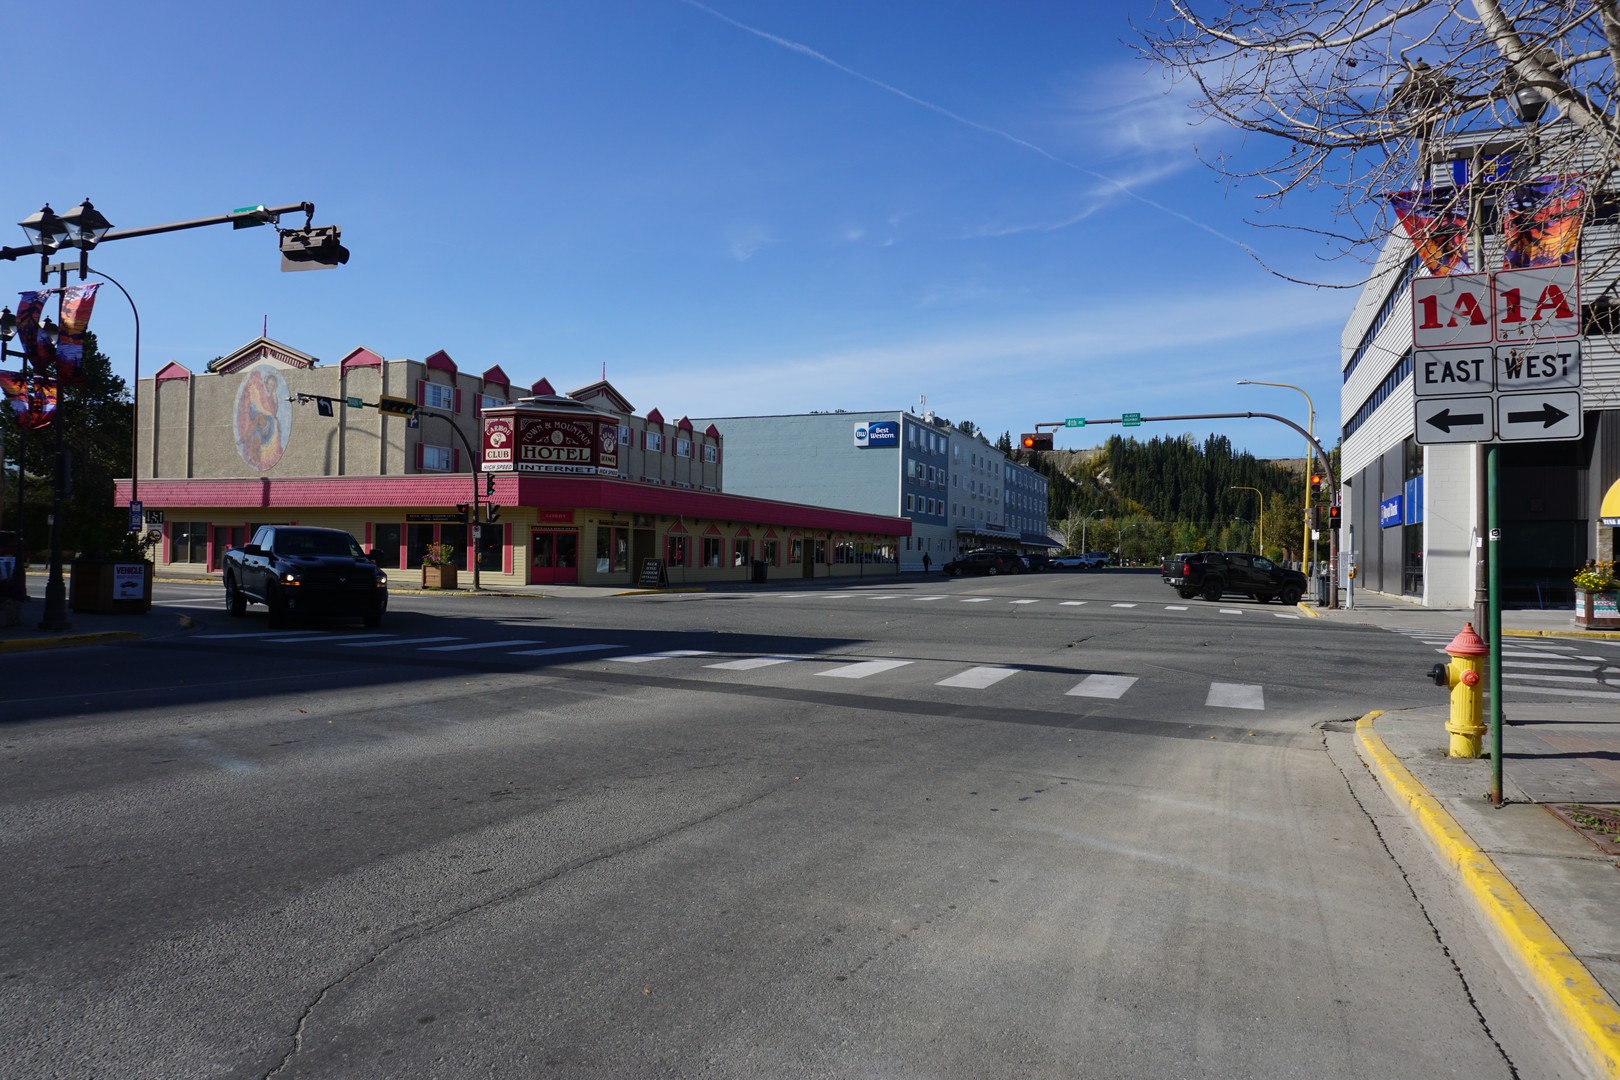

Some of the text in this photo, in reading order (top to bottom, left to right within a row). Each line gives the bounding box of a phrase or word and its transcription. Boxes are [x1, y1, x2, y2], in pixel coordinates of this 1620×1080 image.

[1418, 293, 1487, 330] 1A
[1501, 284, 1574, 323] 1A
[1425, 358, 1485, 384] EAST
[1504, 353, 1572, 380] WEST
[523, 424, 544, 443] TOWN
[554, 421, 592, 446] MOUNTAIN
[487, 450, 509, 459] CLUB
[523, 446, 590, 461] HOTEL
[520, 465, 594, 473] INTERNET
[116, 566, 143, 575] VEHICLE
